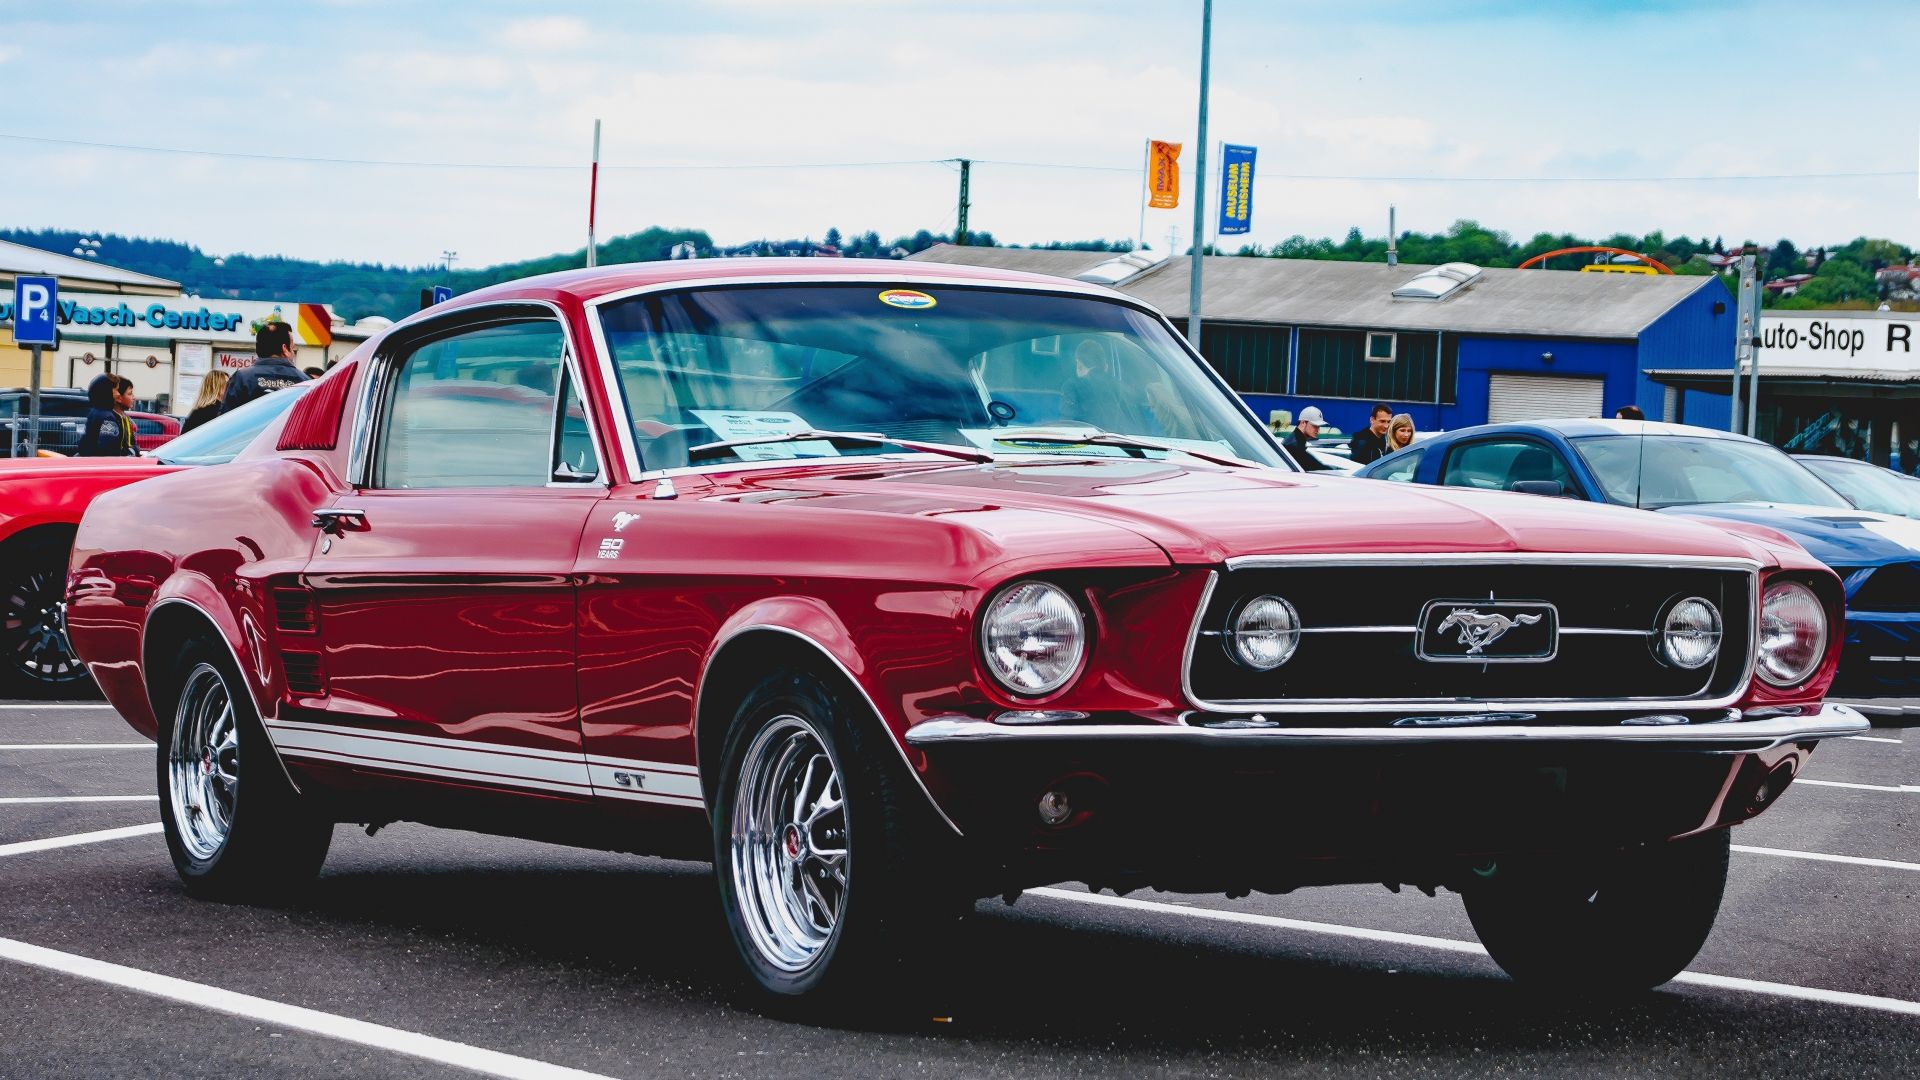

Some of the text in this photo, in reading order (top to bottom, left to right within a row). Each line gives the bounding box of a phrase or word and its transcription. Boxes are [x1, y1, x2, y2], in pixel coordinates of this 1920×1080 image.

[1225, 163, 1239, 218] MUSEUM
[1237, 162, 1250, 220] SINSHEIM
[22, 284, 49, 321] P 4
[1759, 321, 1912, 357] uto-Shop R
[597, 550, 619, 559] YEARS
[600, 538, 624, 550] 50
[614, 772, 646, 788] GT
